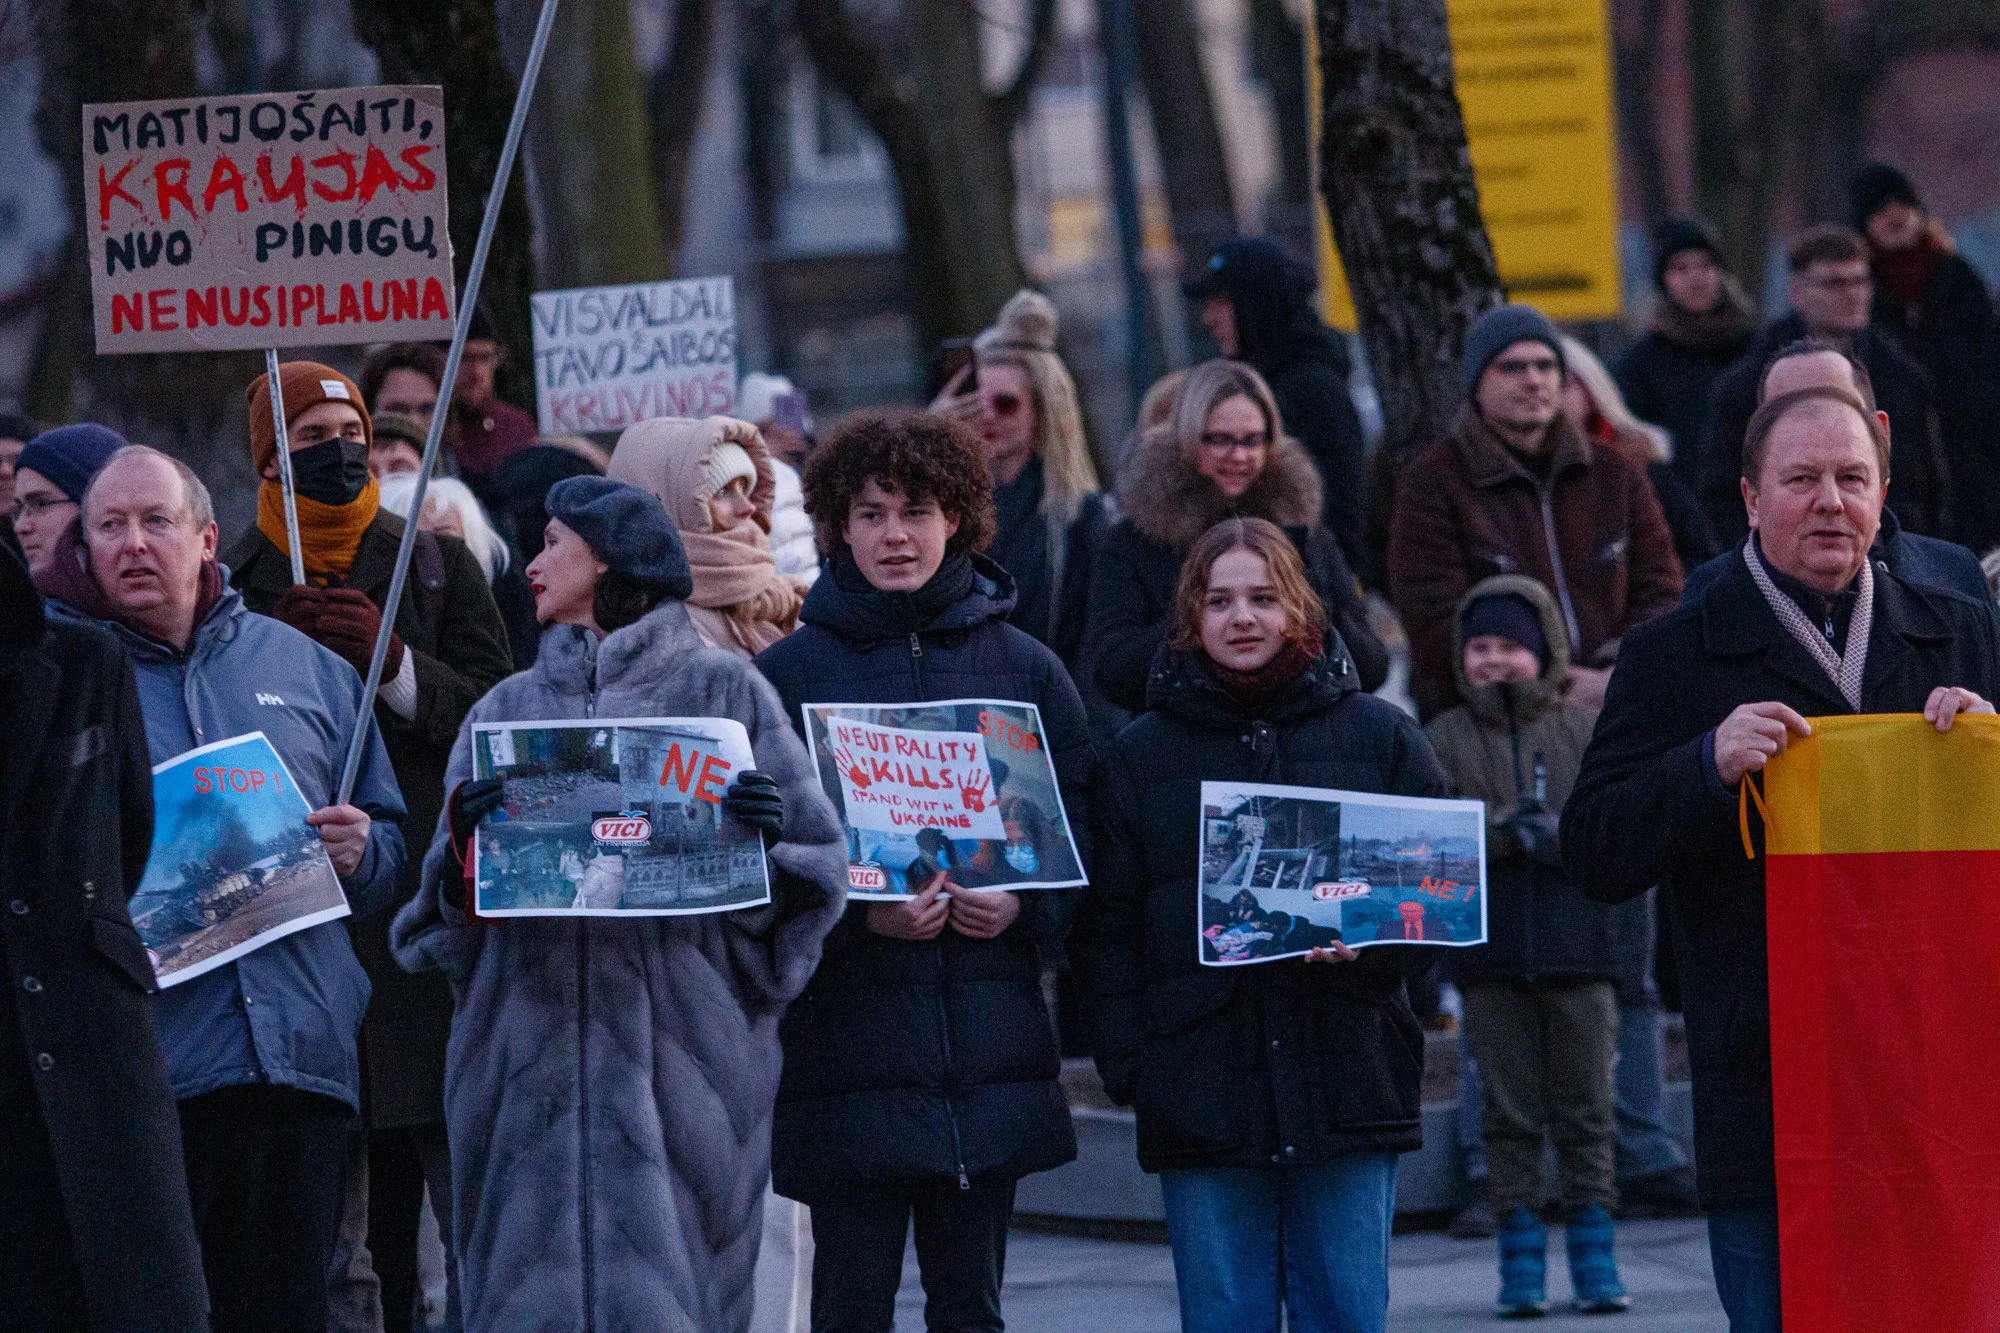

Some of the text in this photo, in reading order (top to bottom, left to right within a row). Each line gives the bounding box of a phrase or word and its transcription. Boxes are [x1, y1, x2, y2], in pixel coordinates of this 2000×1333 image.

[93, 92, 433, 154] MATIJOŠAITI,
[98, 143, 438, 224] KRAUJAS
[106, 216, 438, 276] NUO PINIGŲ
[111, 276, 450, 334] NENUSIPLAUNA
[536, 327, 734, 388] TAVO ŠAIBOS
[551, 371, 733, 429] KRUVINOS
[837, 725, 977, 763] NEUTRALITY
[976, 711, 1039, 755] STOP
[659, 742, 732, 804] NE
[870, 756, 954, 790] KILLS
[852, 789, 954, 812] STAND WITH
[889, 808, 972, 829] UKRAINE
[601, 822, 645, 837] VICI
[849, 871, 879, 885] VICI
[1321, 884, 1362, 898] VICI
